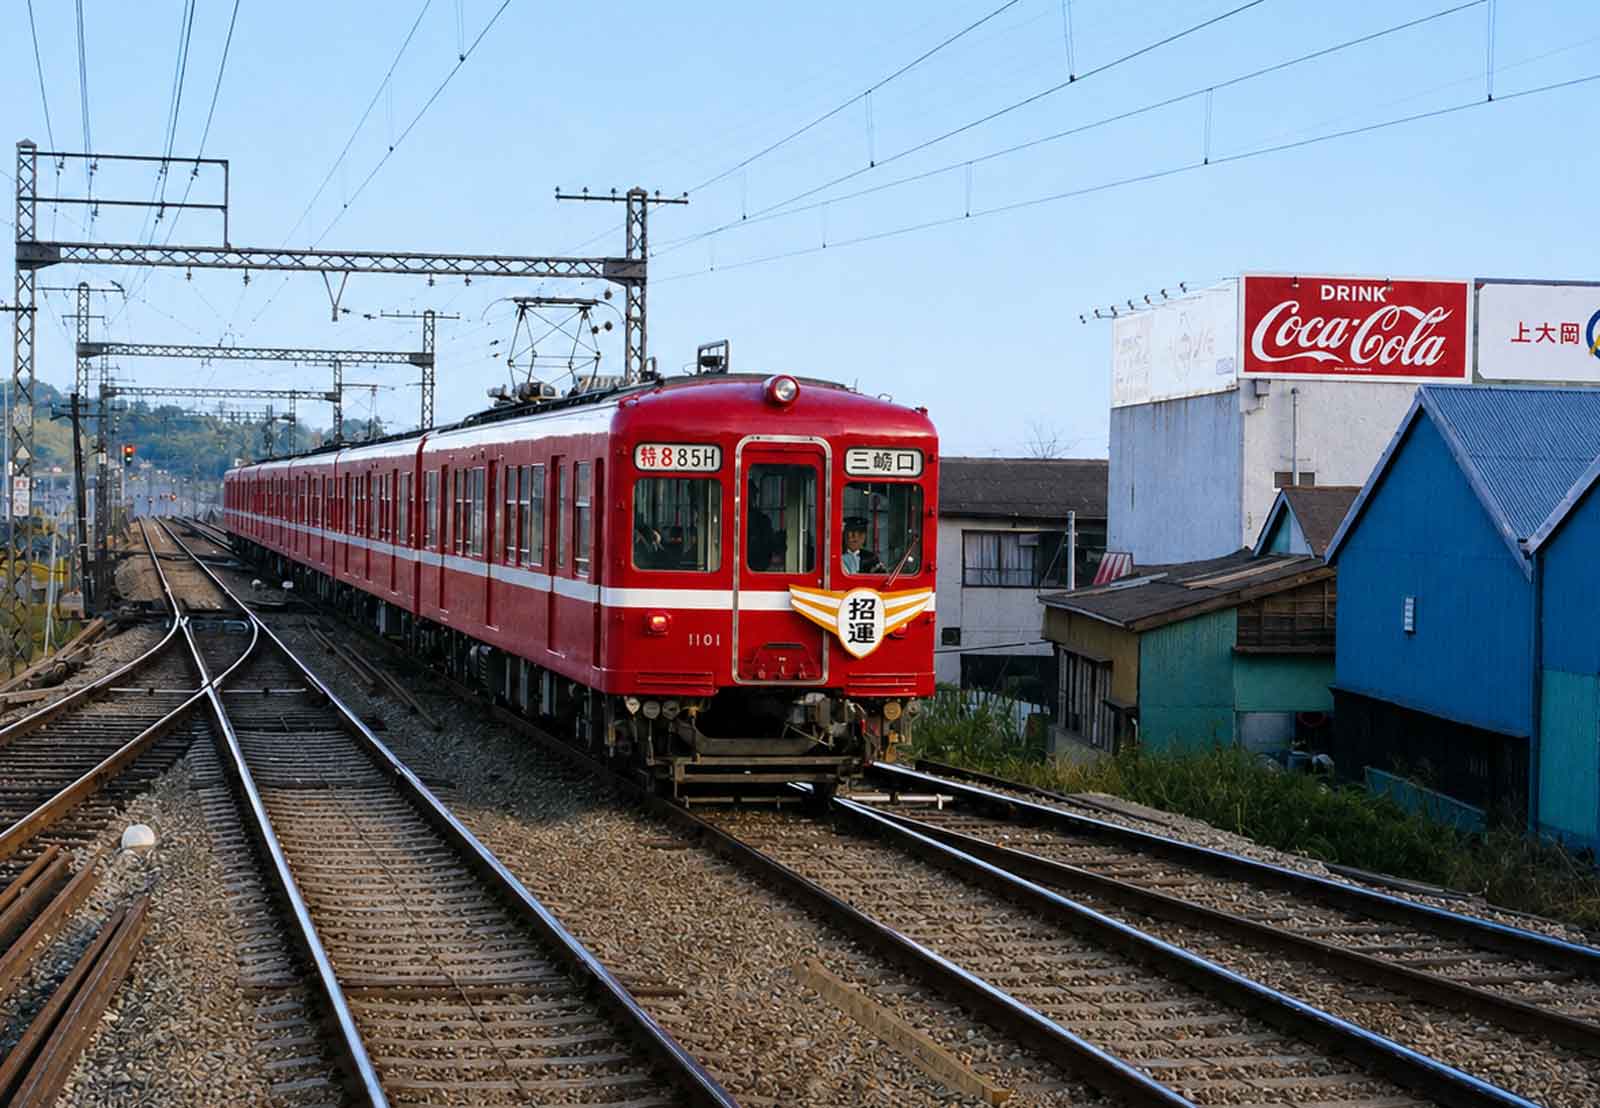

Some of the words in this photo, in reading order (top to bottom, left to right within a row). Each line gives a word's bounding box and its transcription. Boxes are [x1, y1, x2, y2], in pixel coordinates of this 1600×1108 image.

[1321, 285, 1386, 301] DRINK
[1511, 321, 1580, 344] 上大岡
[689, 633, 720, 646] 1101
